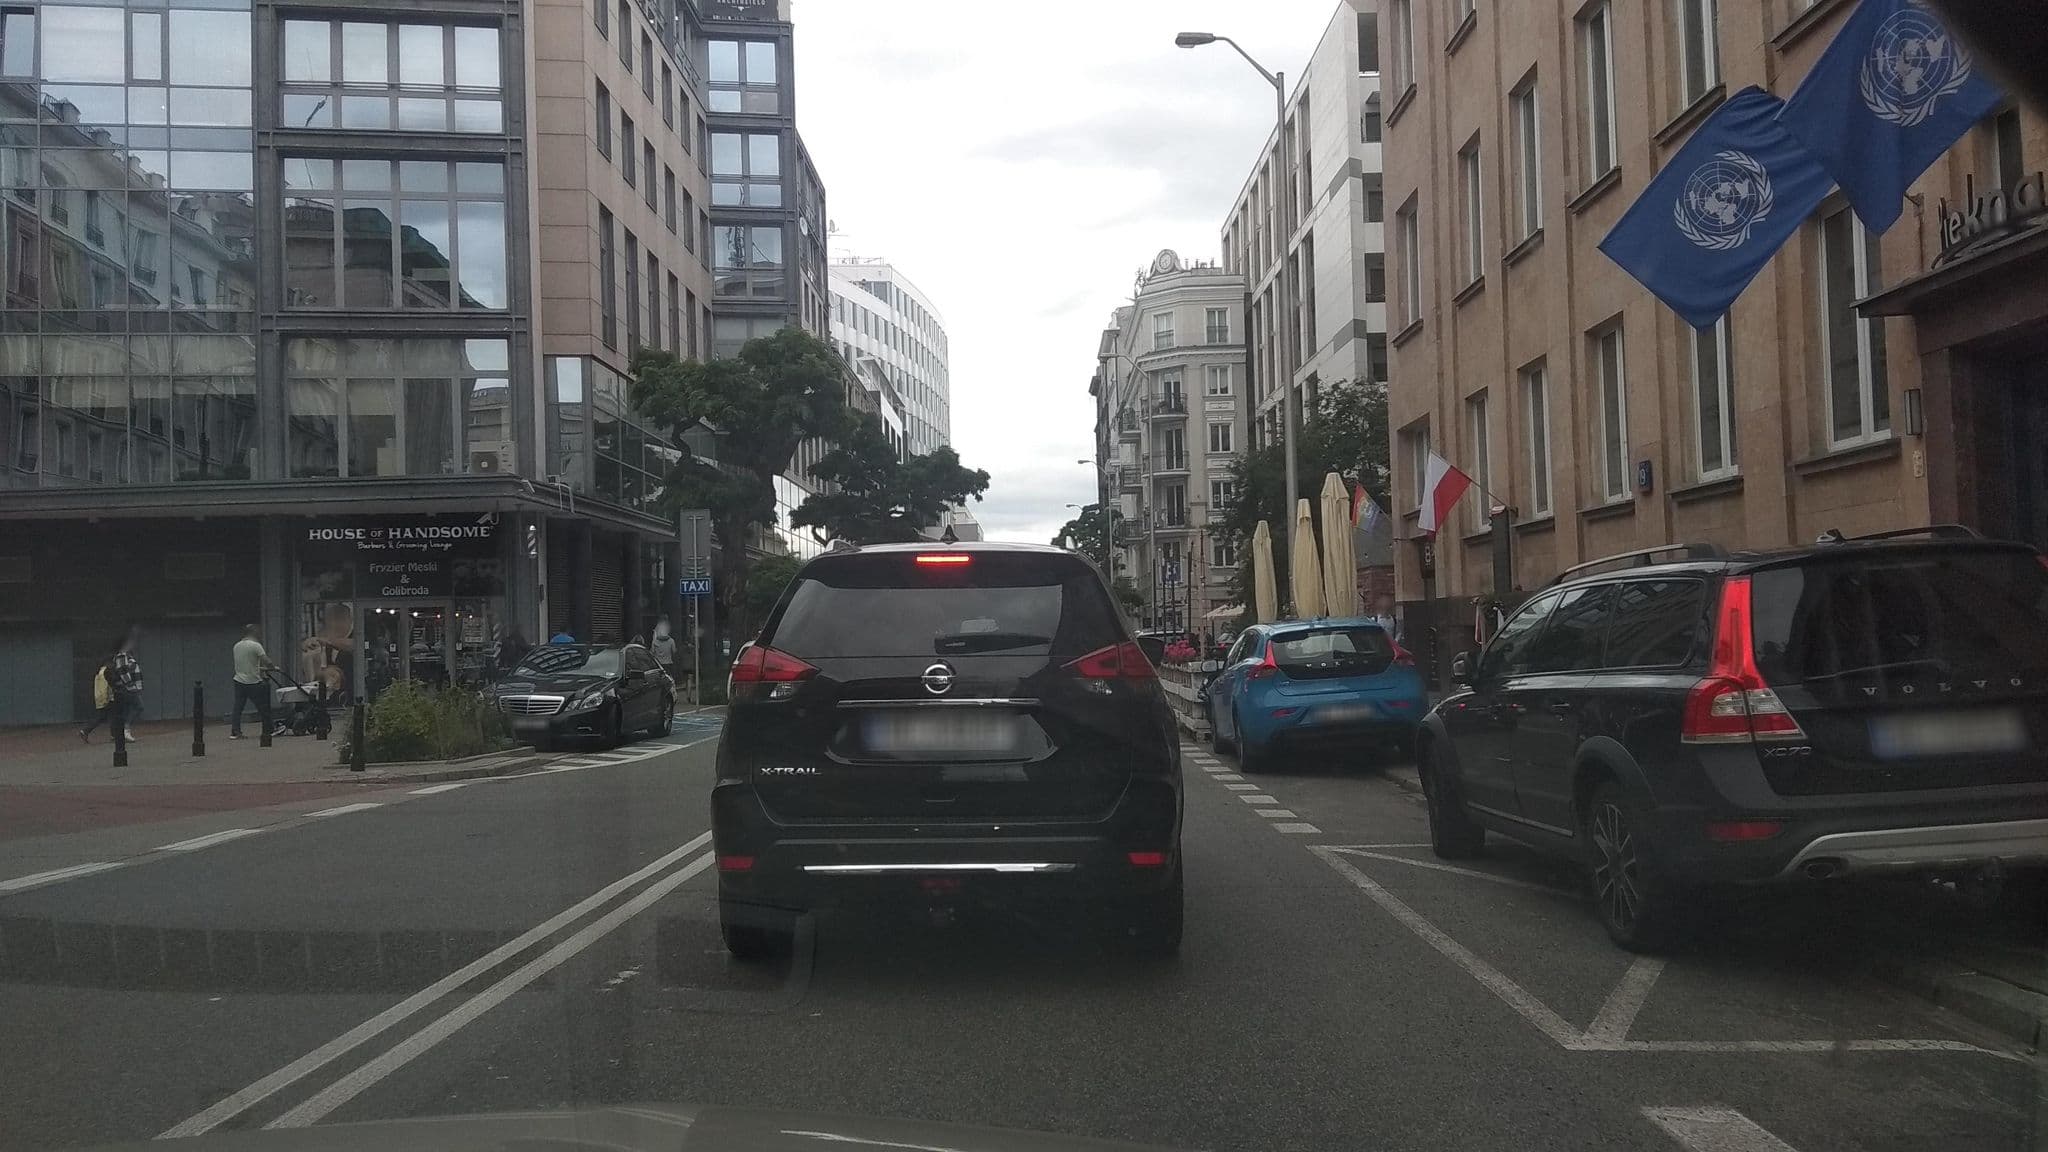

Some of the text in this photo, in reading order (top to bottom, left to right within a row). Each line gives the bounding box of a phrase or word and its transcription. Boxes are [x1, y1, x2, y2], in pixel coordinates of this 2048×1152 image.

[309, 526, 490, 540] HOUSE OF HANDSOME
[357, 541, 386, 549] Barbers
[400, 574, 410, 584] &
[382, 586, 429, 596] Golibroda
[682, 581, 709, 591] TAXI
[1862, 678, 2022, 696] VOLVO
[760, 767, 822, 776] X-TRAIL
